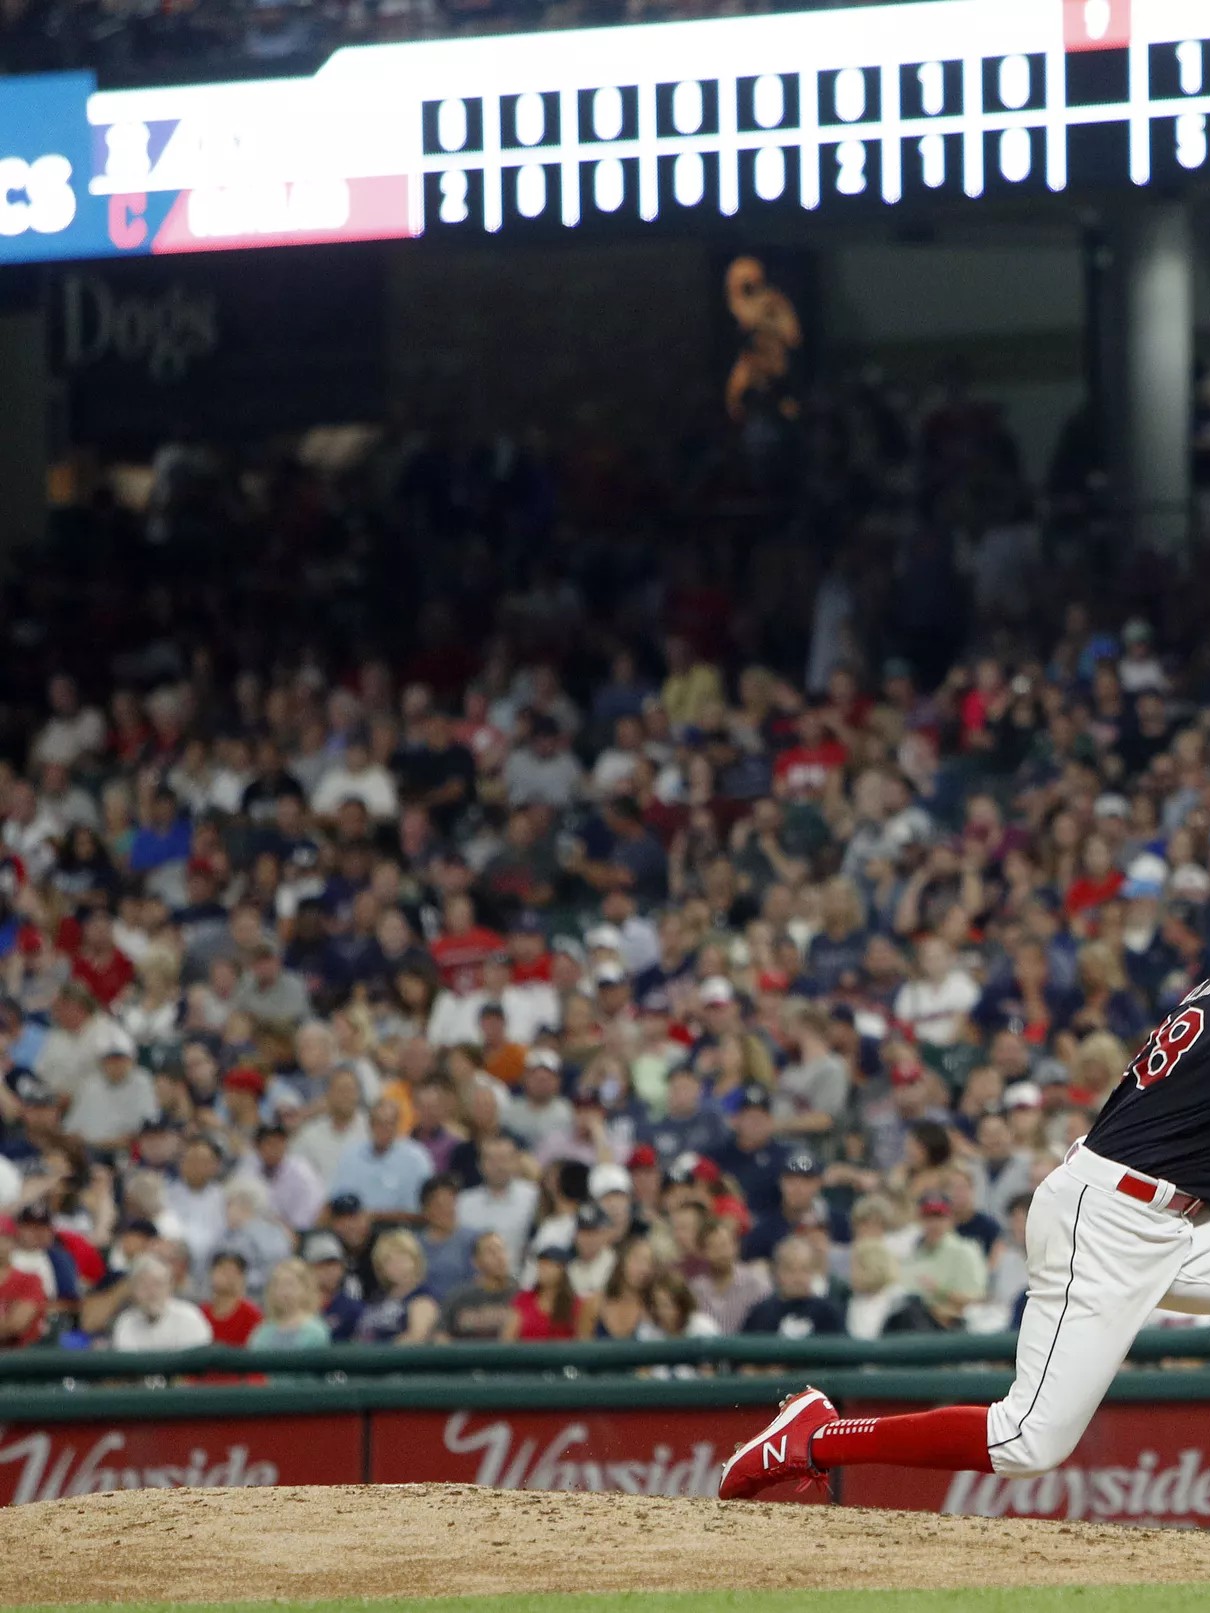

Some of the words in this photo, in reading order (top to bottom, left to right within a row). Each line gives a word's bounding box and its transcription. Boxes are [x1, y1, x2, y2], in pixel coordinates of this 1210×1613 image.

[438, 98, 467, 152] 0
[515, 92, 545, 146] 0
[592, 87, 623, 140] 0
[672, 80, 703, 134] 0
[753, 74, 784, 128] 0
[834, 68, 866, 122] 0
[917, 62, 944, 116] 1
[999, 54, 1030, 110] 0
[1175, 40, 1202, 95] 1
[516, 164, 546, 218] 0
[594, 158, 624, 212] 0
[674, 151, 704, 206] 0
[755, 146, 785, 200] 0
[918, 134, 946, 188] 1
[1000, 127, 1031, 182] 0
[63, 275, 219, 385] Dogs
[443, 1409, 726, 1497] Wasid
[763, 1434, 787, 1469] N
